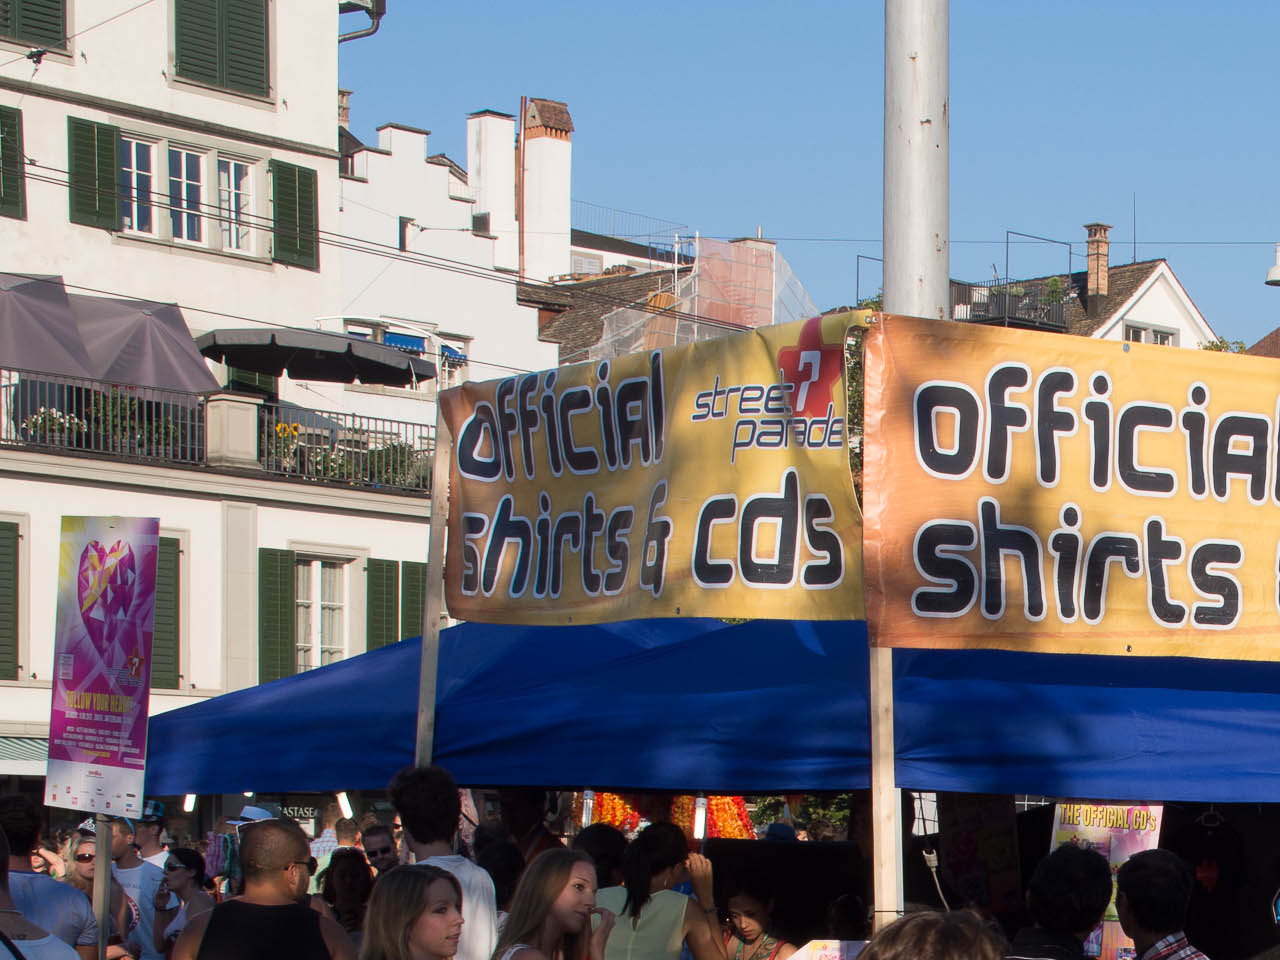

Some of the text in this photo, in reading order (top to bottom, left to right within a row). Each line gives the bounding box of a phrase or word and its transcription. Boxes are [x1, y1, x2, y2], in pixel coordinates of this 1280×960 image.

[691, 368, 794, 422] street
[730, 403, 844, 464] parade
[460, 466, 845, 599] shirts & cds
[911, 495, 1244, 630] shirts
[1060, 804, 1081, 825] THE
[1083, 806, 1130, 829] OFFICIAL
